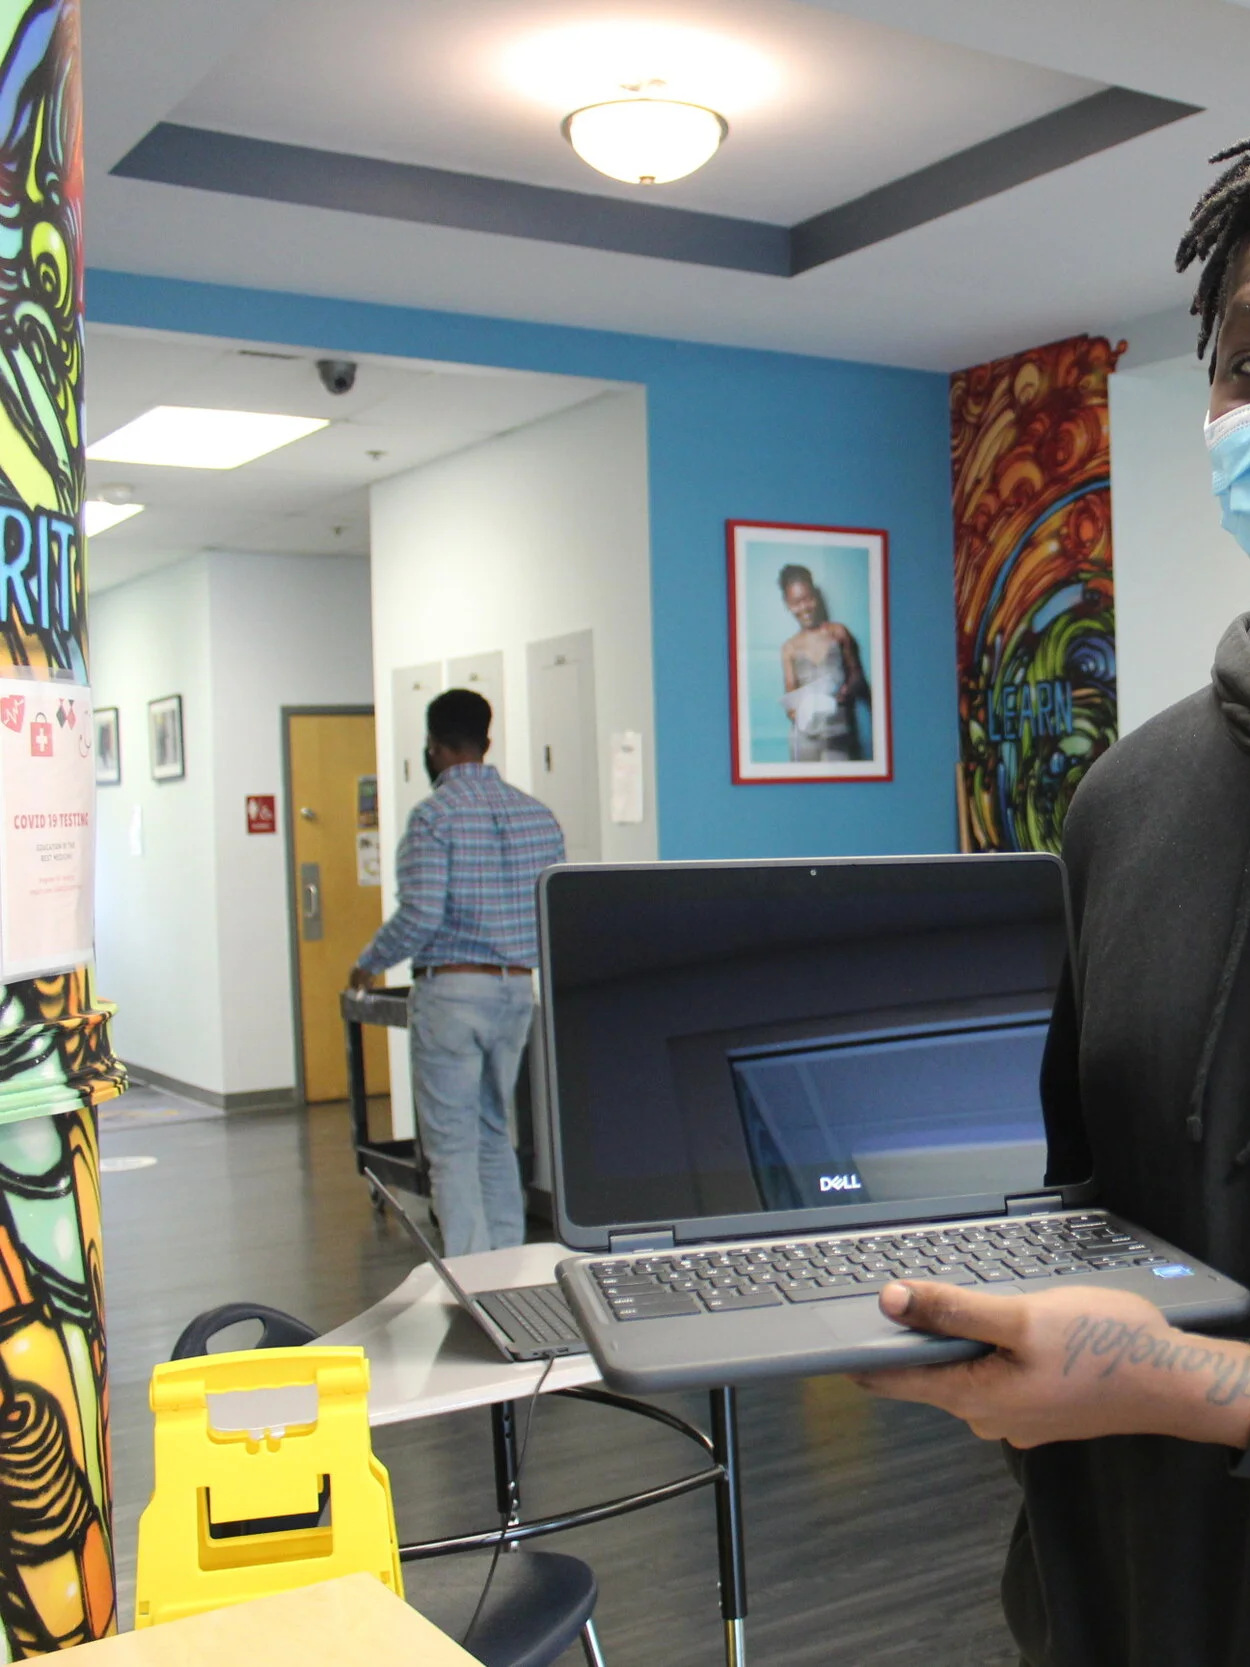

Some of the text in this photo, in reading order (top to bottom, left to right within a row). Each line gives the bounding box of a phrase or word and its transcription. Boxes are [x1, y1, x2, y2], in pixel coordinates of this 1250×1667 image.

[988, 681, 1073, 741] LEARN
[14, 814, 46, 829] COVID
[48, 813, 57, 828] 19
[819, 1174, 862, 1192] DELL
